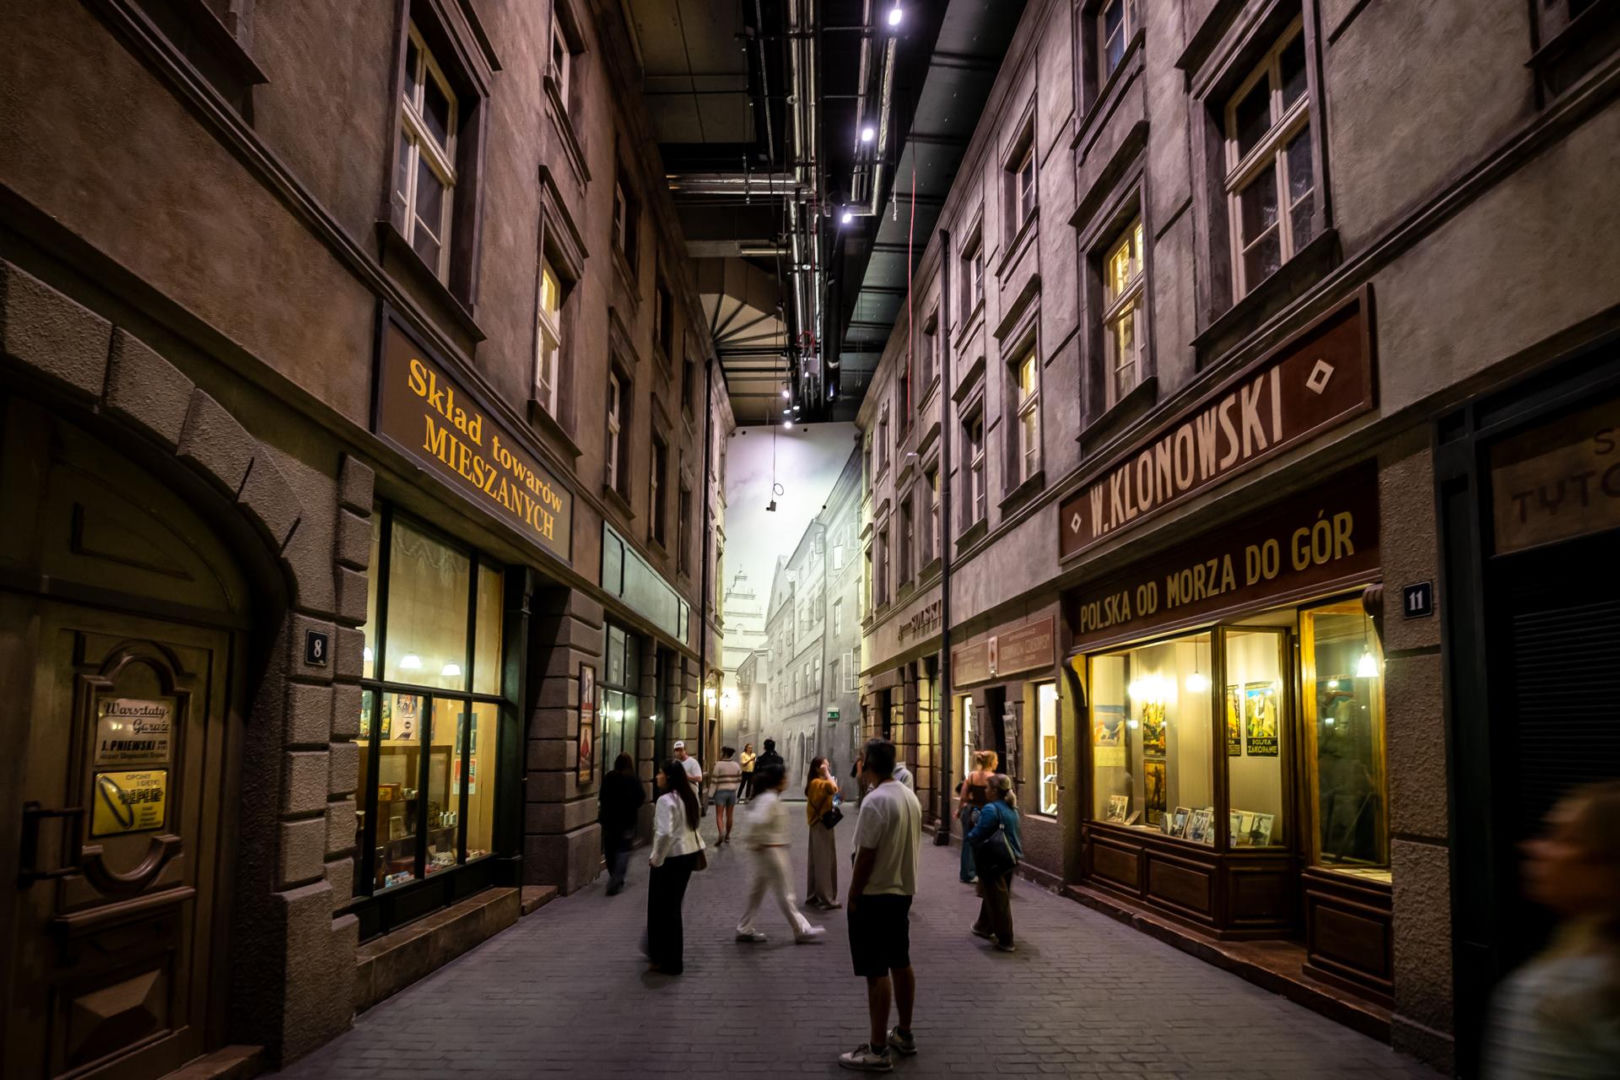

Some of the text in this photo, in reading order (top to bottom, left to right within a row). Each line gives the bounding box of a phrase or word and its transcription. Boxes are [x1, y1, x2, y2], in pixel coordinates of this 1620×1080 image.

[408, 358, 562, 513] Skład towarów
[422, 413, 555, 541] MIESZANYCH
[1080, 508, 1355, 632] POLSKA OD MORZA DO GÓR
[1408, 590, 1424, 611] 11
[313, 639, 322, 658] 8
